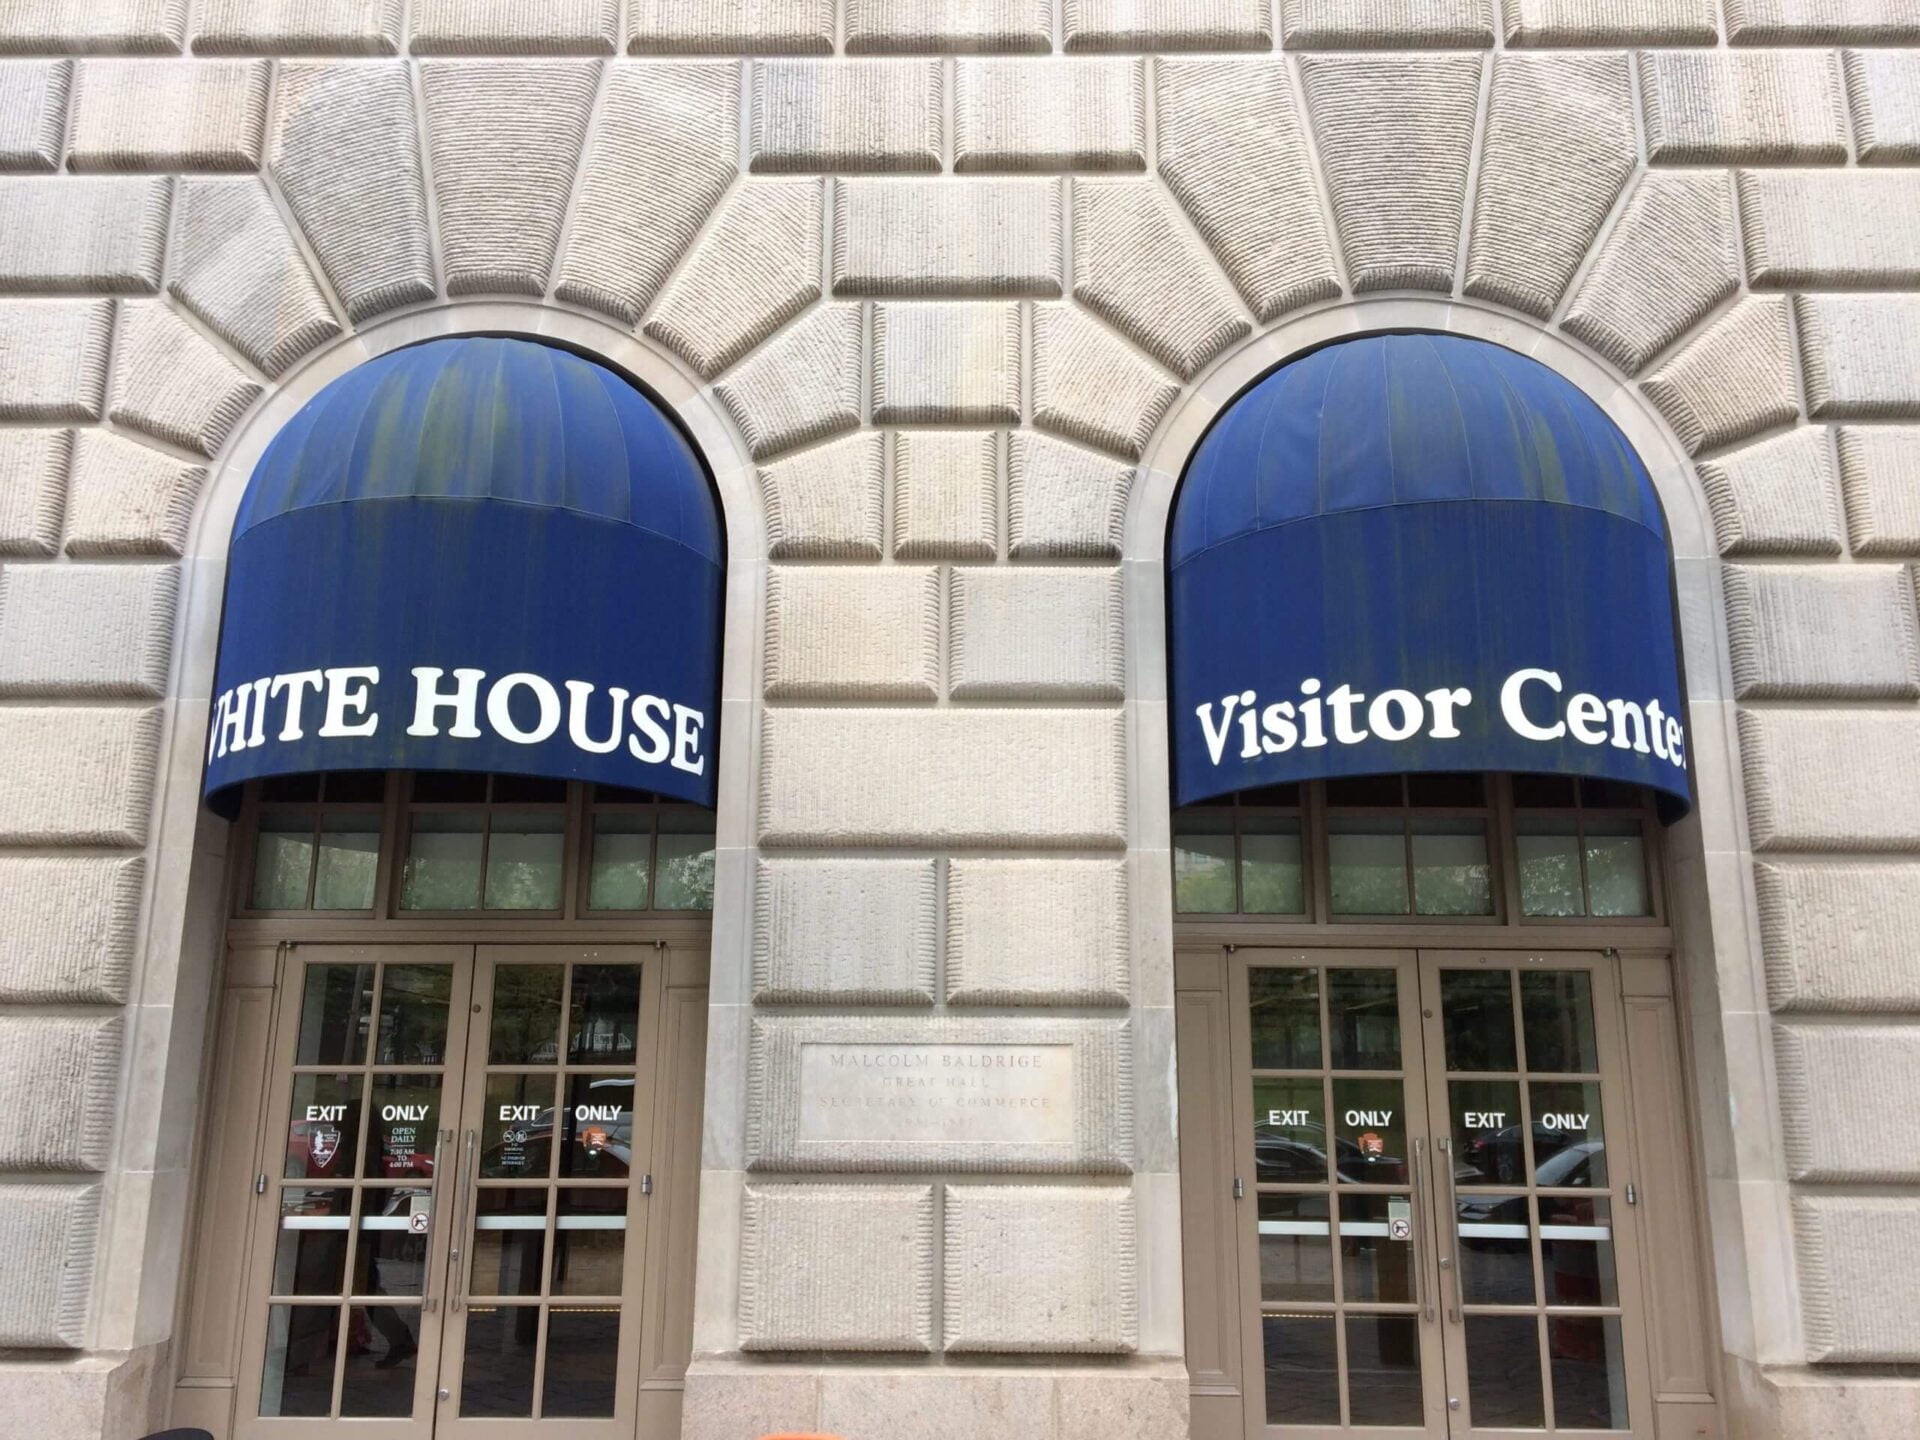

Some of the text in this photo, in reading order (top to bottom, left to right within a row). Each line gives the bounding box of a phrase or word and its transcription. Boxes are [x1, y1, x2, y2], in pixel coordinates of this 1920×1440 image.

[406, 667, 705, 776] HOUSE
[1196, 678, 1472, 766] Visitor
[830, 1054, 1043, 1069] MALCOLM BALDRIGE
[882, 1077, 990, 1088] GREAT HALL
[306, 1105, 429, 1122] EXIT ONLY
[499, 1105, 622, 1121] EXIT ONLY
[1269, 1110, 1392, 1127] EXIT ONLY
[1464, 1112, 1590, 1130] EXIT ONLY
[391, 1135, 416, 1143] DAILY
[392, 1127, 416, 1135] OPEN
